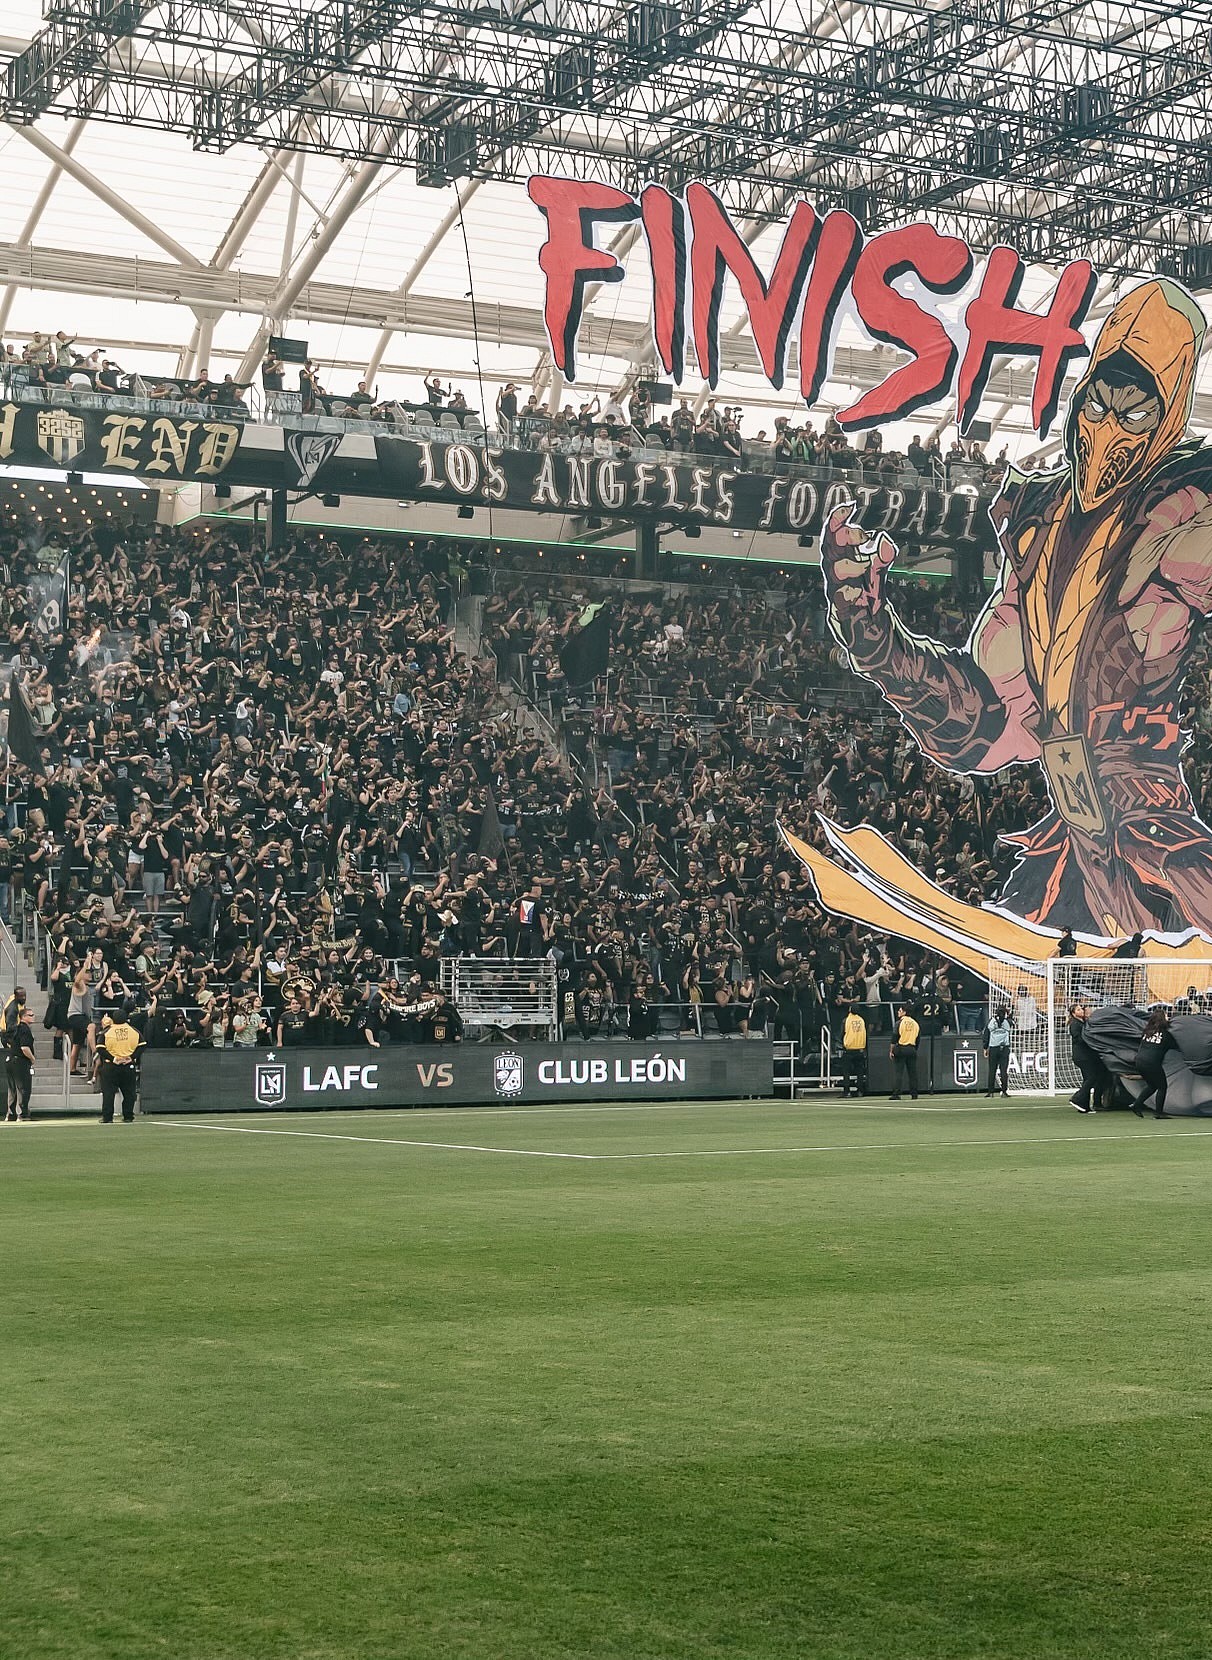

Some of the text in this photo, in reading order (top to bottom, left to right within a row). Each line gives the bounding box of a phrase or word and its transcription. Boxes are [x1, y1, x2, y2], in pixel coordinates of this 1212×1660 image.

[527, 176, 1098, 441] FINISH
[39, 418, 84, 440] 3252
[100, 414, 239, 476] END
[416, 440, 509, 501] LOS
[531, 451, 737, 522] ANGELES
[303, 1063, 454, 1091] LAFC VS
[538, 1053, 686, 1084] CLUB LEÓN
[998, 1052, 1048, 1074] AFC
